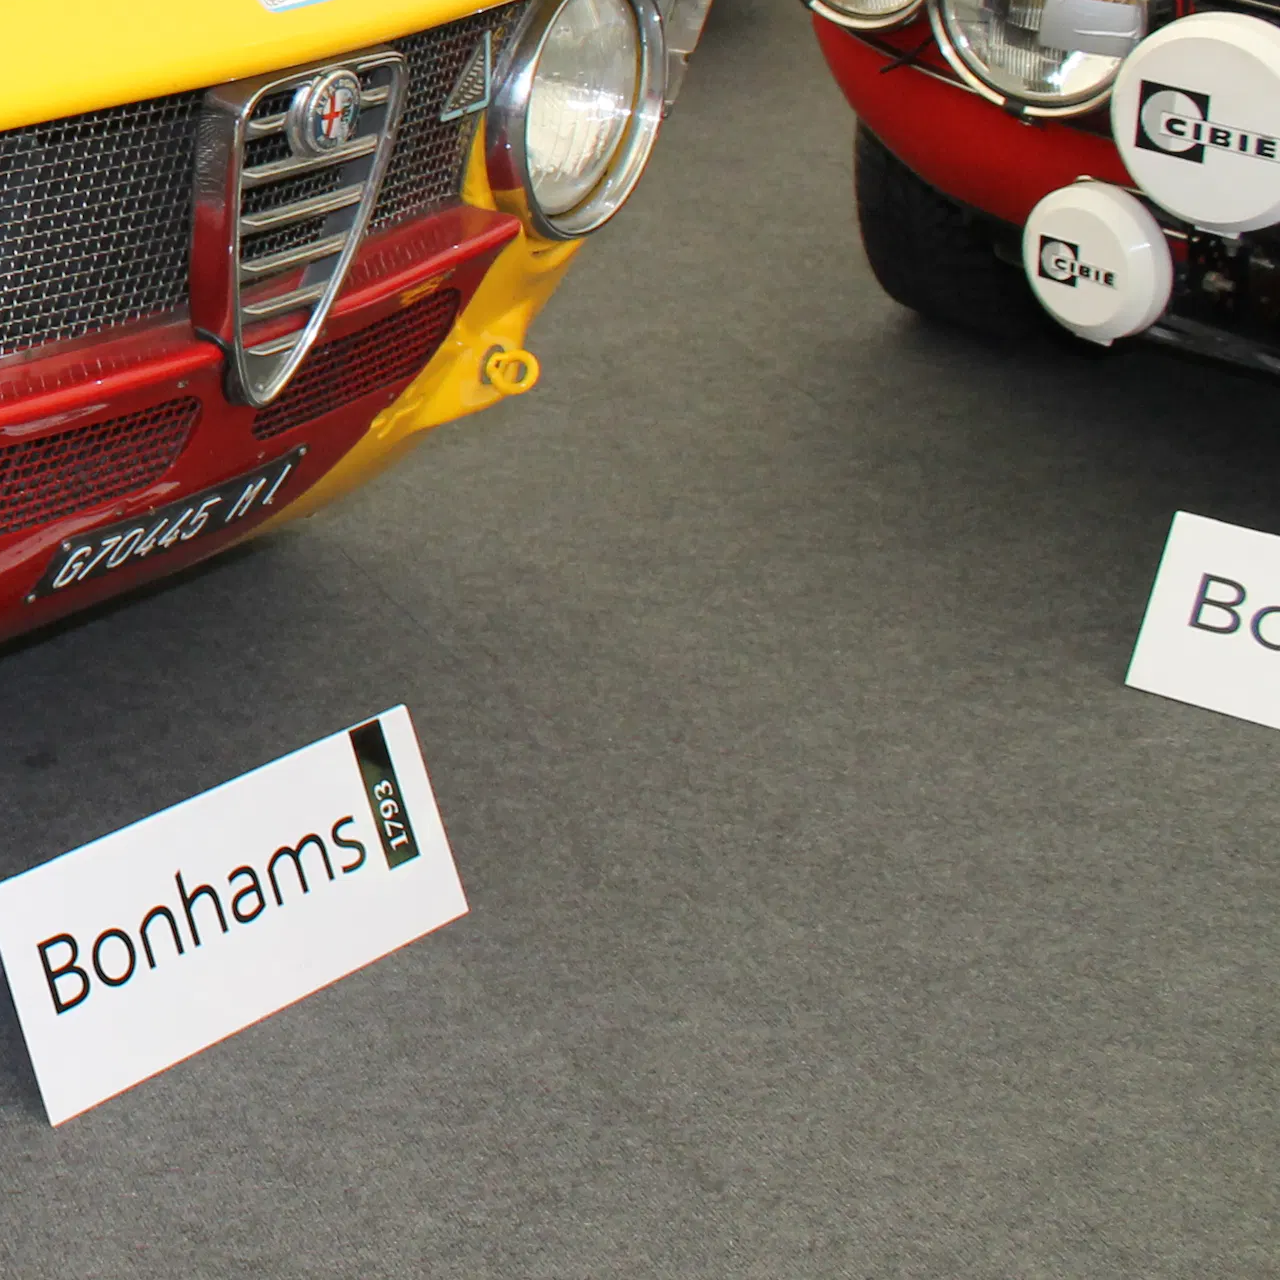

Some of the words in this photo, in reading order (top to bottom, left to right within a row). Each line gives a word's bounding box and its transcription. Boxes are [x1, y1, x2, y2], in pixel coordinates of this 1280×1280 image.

[1165, 117, 1277, 159] CIBIE
[1054, 258, 1115, 287] CIBIE
[372, 778, 409, 851] 1793
[37, 815, 367, 1016] Bonhams
